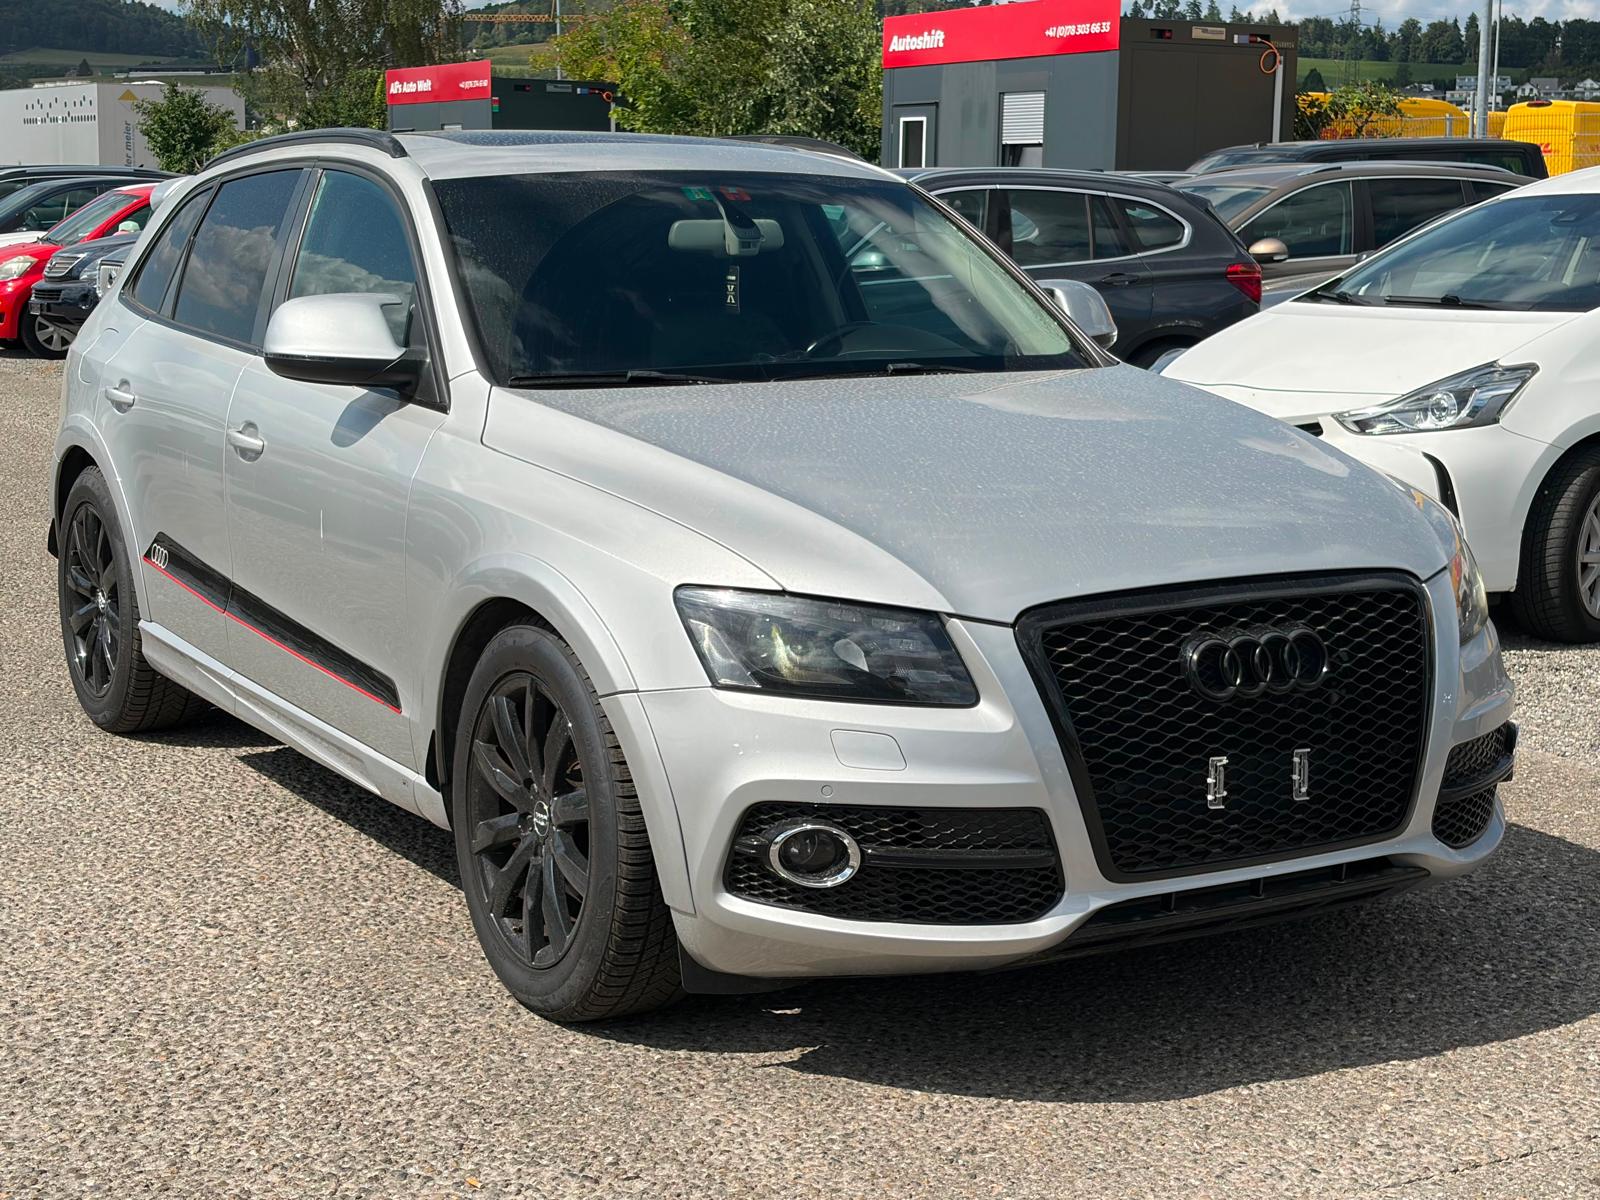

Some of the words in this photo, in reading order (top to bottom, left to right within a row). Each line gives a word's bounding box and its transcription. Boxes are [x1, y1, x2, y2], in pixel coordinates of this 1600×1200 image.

[1045, 27, 1056, 37] +41
[1075, 24, 1090, 35] 303
[1090, 22, 1101, 33] 66
[1101, 21, 1111, 32] 33
[888, 29, 945, 52] Autoshift
[402, 81, 417, 93] Auto
[417, 79, 432, 92] Welt
[123, 120, 131, 151] meier
